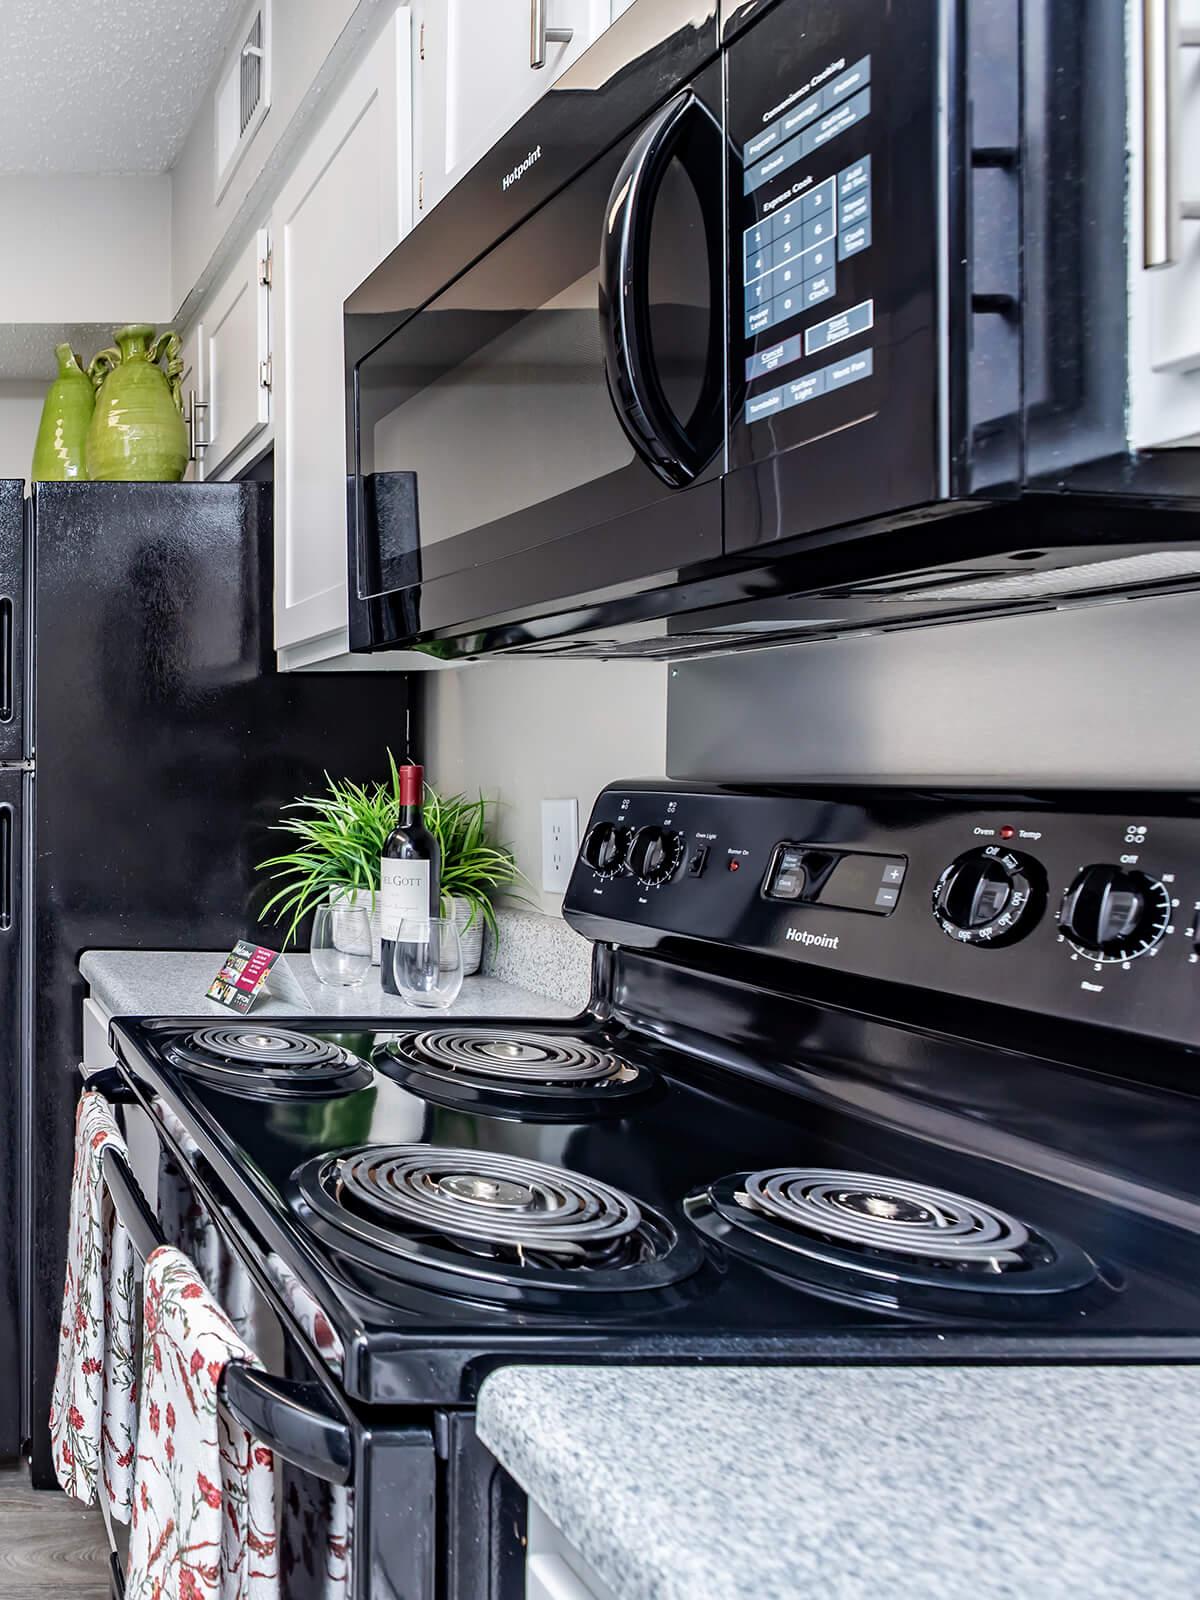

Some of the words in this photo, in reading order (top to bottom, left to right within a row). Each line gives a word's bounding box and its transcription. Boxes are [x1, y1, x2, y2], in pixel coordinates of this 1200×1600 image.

[502, 145, 541, 191] Hotpoint
[763, 190, 792, 212] Express
[792, 175, 813, 193] Cook
[814, 195, 822, 206] 3
[784, 214, 791, 224] 2
[814, 224, 822, 235] 6
[755, 232, 761, 241] 1
[784, 241, 791, 253] 5
[755, 259, 761, 268] 4
[815, 254, 823, 264] 9
[784, 271, 791, 280] 8
[784, 299, 792, 309] 0
[761, 345, 783, 361] Cancel
[973, 827, 995, 836] Oven
[1019, 830, 1042, 840] Temp
[985, 846, 1000, 856] Off
[1120, 855, 1138, 864] Off
[786, 928, 839, 949] Hotpoint
